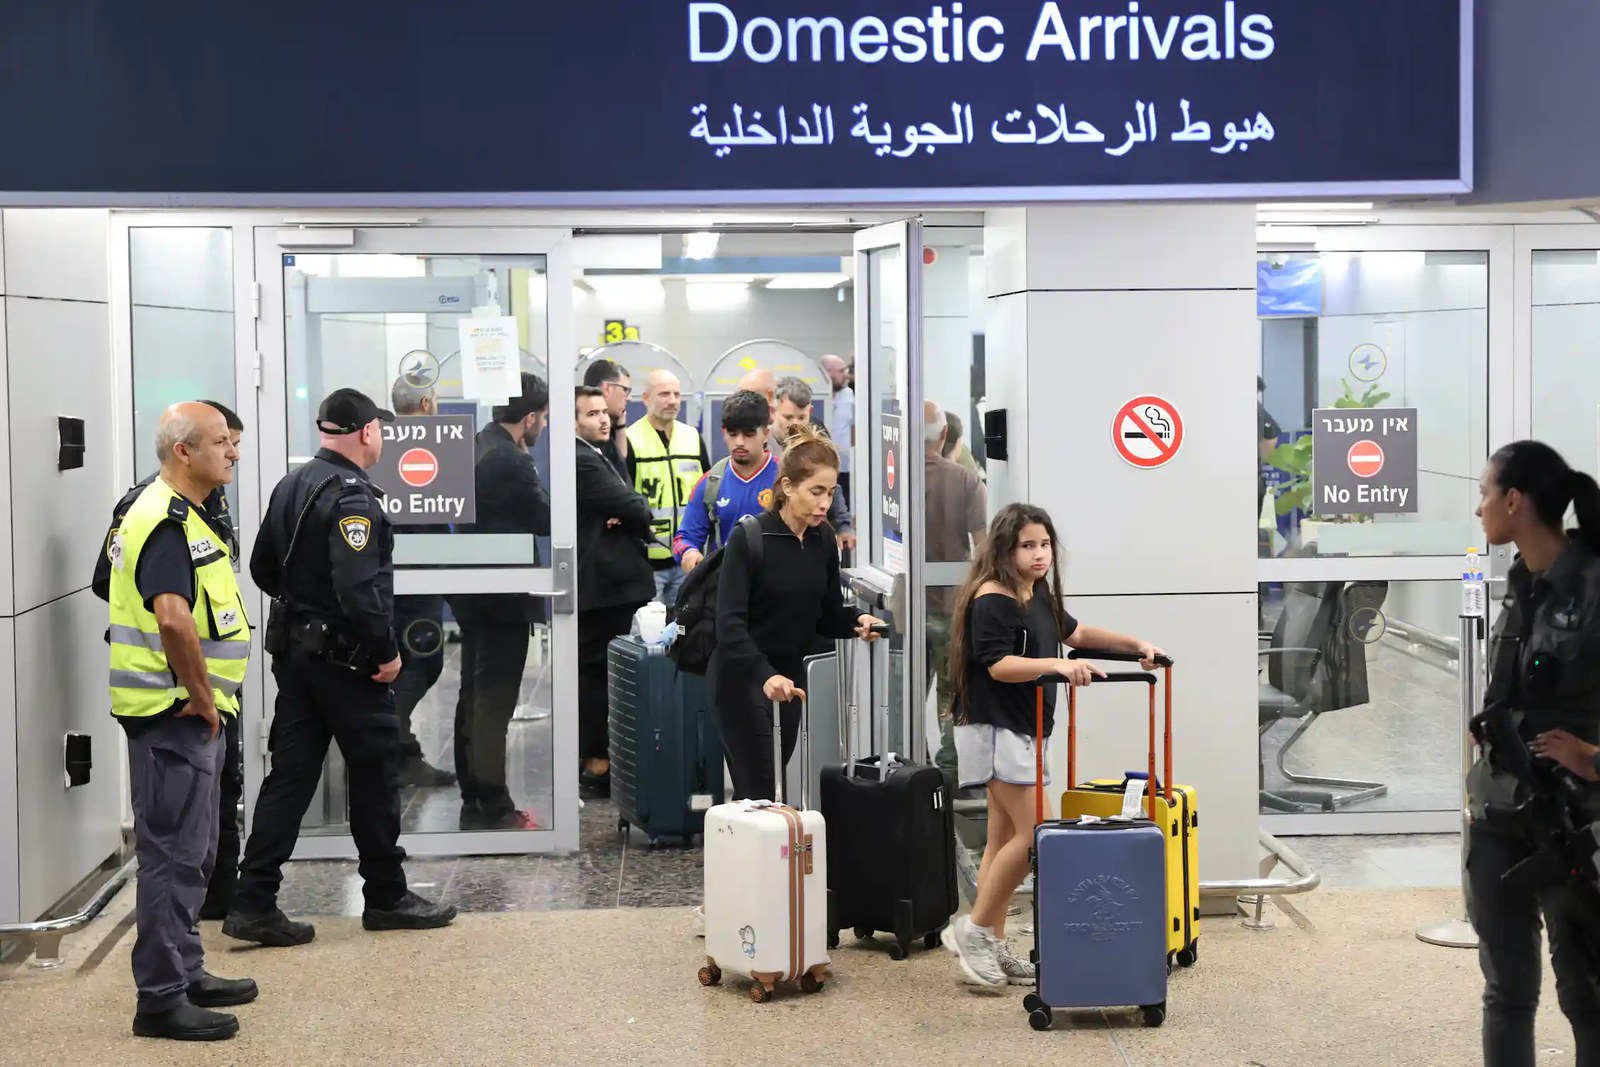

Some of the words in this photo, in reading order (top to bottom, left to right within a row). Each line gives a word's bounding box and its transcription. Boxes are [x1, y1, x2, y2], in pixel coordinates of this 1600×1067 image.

[689, 2, 1004, 63] Domestic
[1025, 0, 1275, 61] Arrivals
[689, 102, 834, 158] الداخلية
[851, 101, 974, 157] الجوية
[991, 100, 1157, 156] الرحلات
[1170, 98, 1275, 154] هبوط
[383, 425, 427, 442] מעב
[436, 425, 464, 444] אין
[1322, 417, 1374, 434] מעבר
[1382, 417, 1408, 436] אין
[375, 494, 402, 513] No
[409, 494, 465, 517] Entry
[1324, 485, 1350, 503] No
[1357, 484, 1409, 507] Entry
